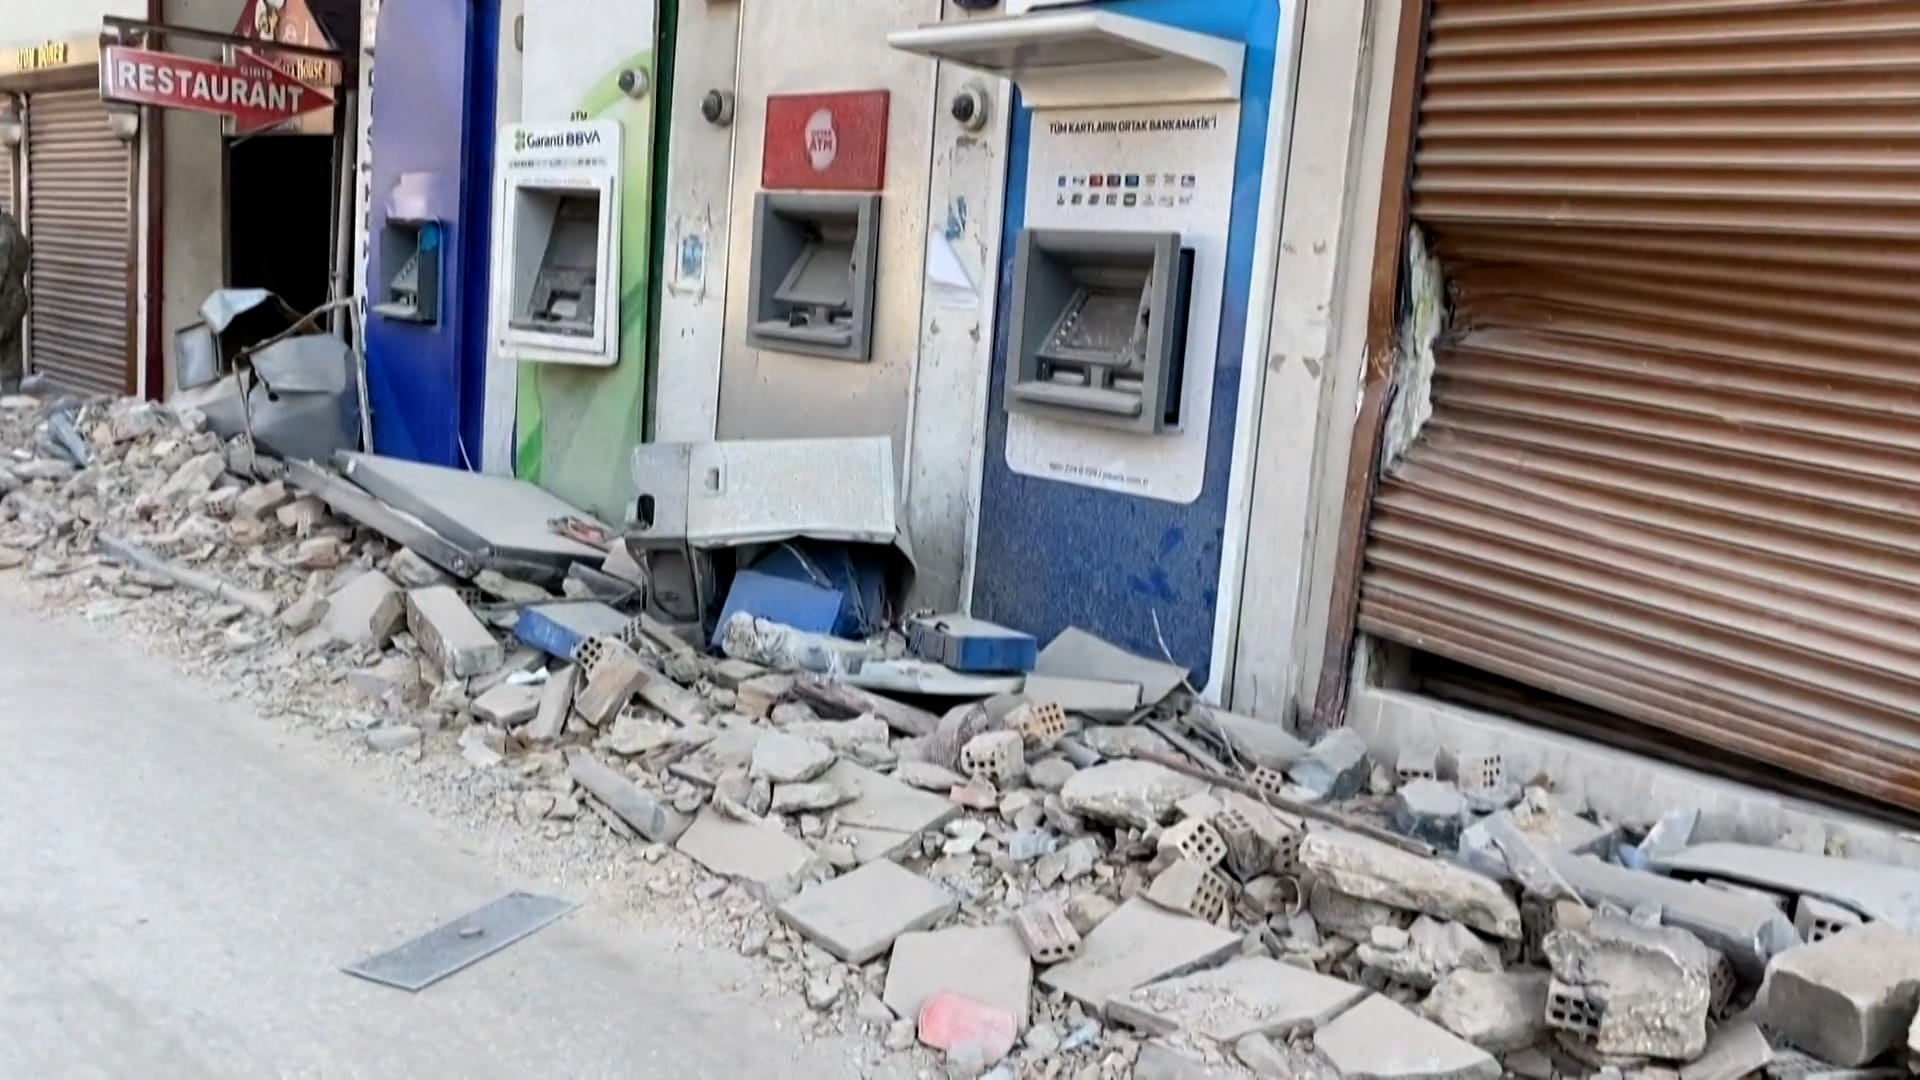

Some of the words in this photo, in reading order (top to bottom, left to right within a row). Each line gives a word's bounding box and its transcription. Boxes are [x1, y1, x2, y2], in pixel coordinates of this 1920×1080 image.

[118, 60, 303, 113] RESTAURANT
[570, 111, 588, 121] ATM
[1049, 120, 1067, 135] TÜM
[1068, 119, 1117, 134] KARTLARIN
[1118, 119, 1148, 133] ORTAK
[527, 133, 564, 148] Garanti
[566, 130, 600, 146] BBVA
[810, 136, 833, 152] ATM
